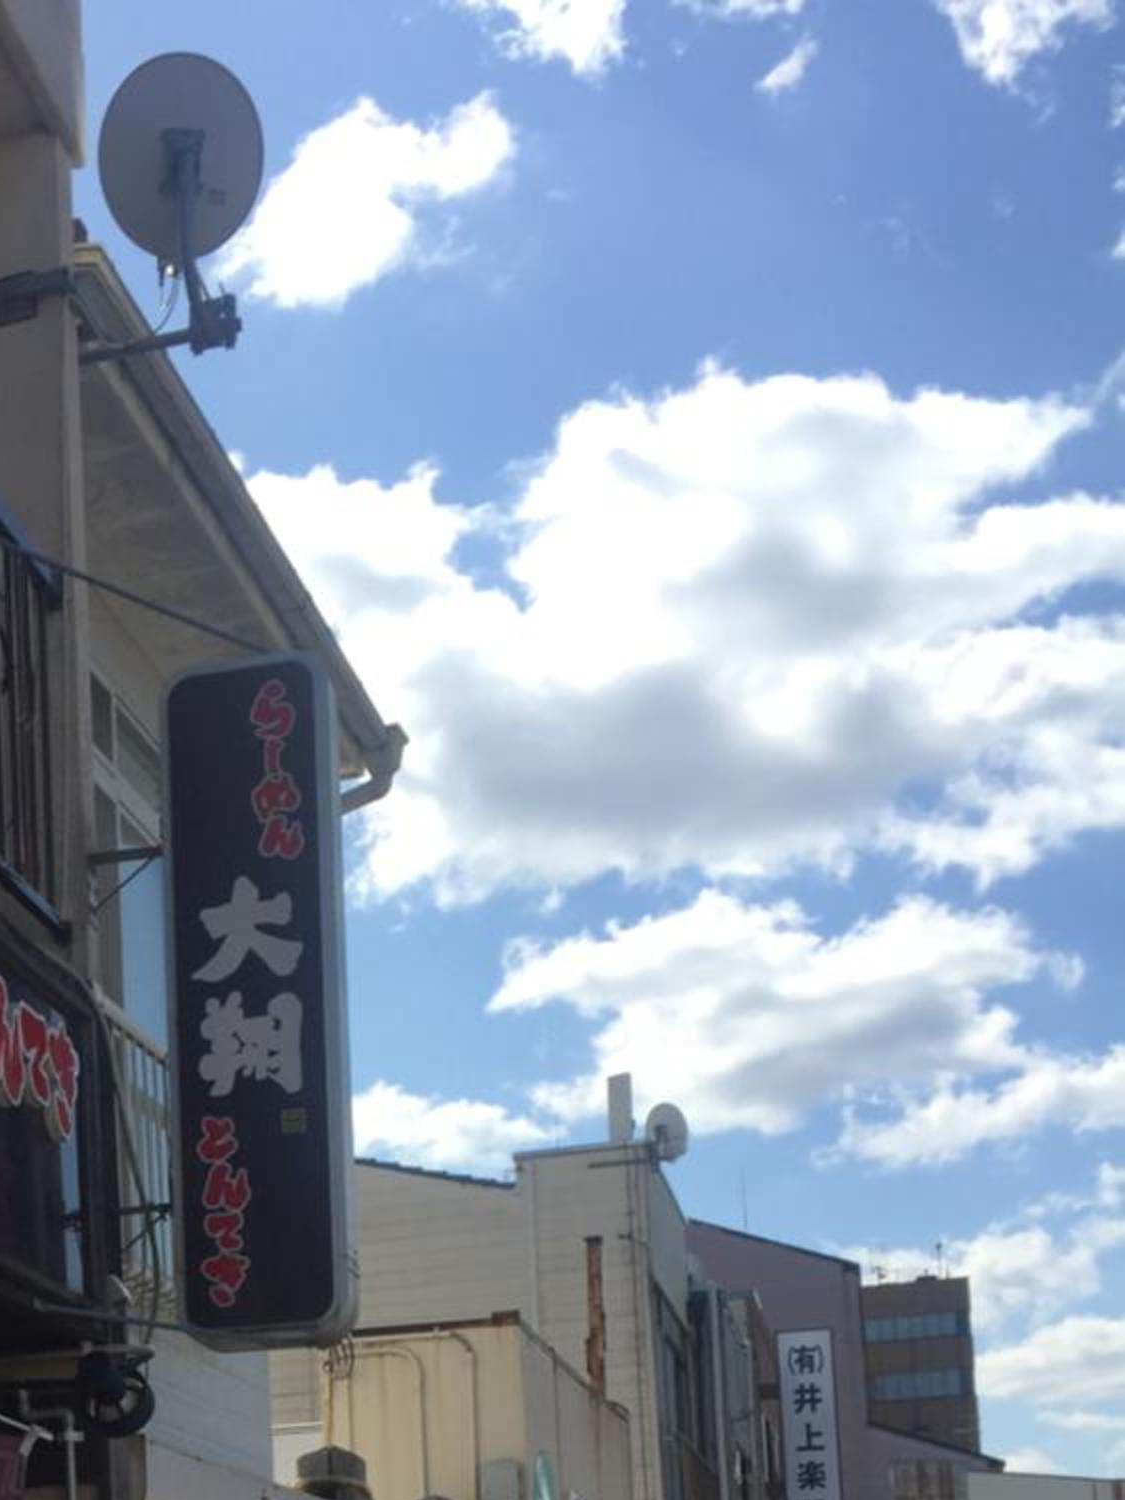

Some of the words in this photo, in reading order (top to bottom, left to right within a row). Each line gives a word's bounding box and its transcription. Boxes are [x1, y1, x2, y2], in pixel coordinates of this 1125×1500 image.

[250, 679, 305, 860] らーめん
[191, 875, 305, 1098] 大翔
[196, 1114, 251, 1309] とんてき
